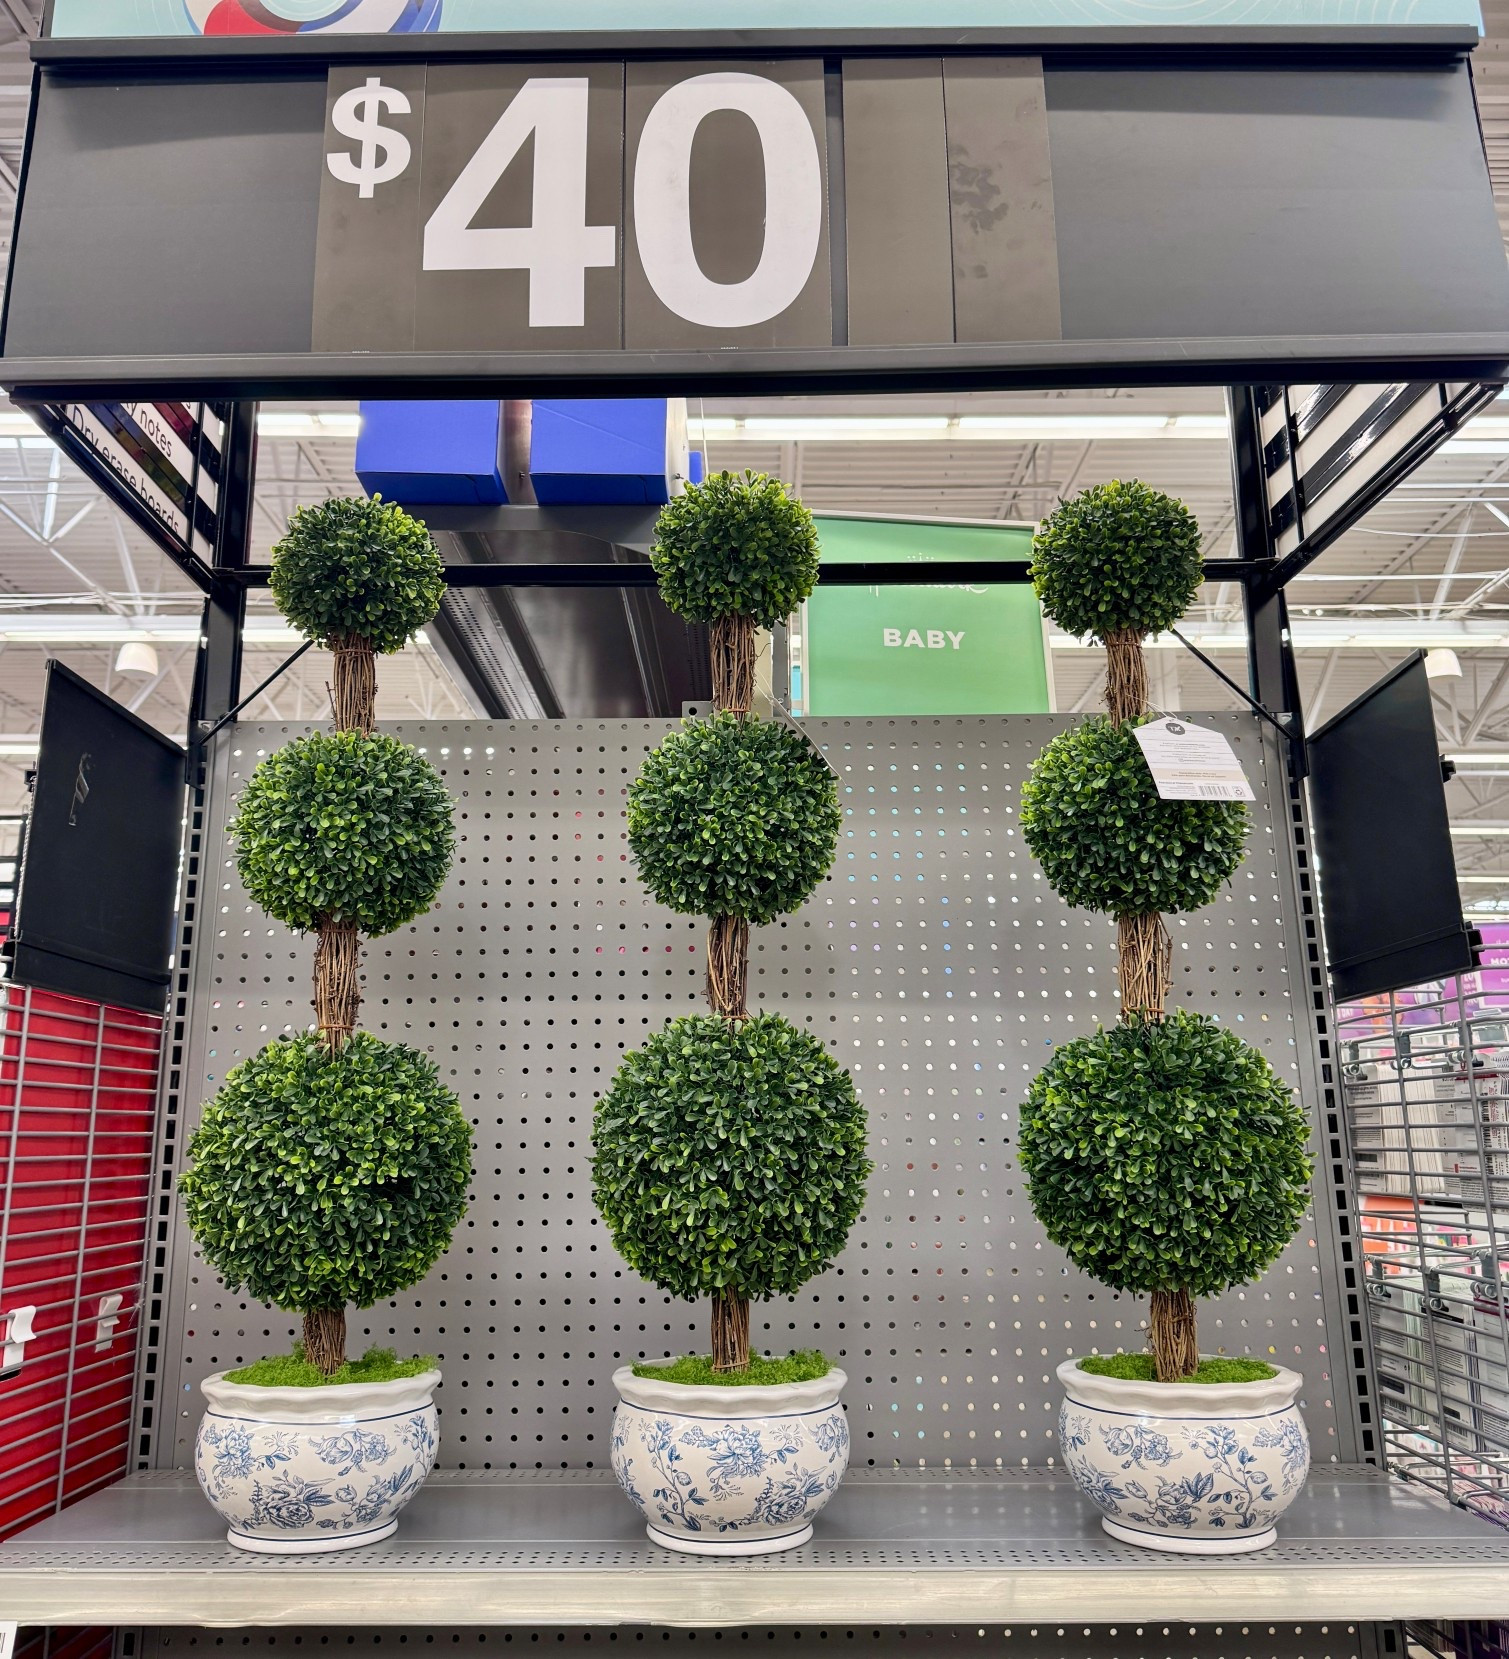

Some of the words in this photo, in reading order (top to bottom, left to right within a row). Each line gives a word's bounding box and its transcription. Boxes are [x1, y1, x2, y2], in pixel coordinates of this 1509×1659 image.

[140, 410, 173, 458] notes
[72, 404, 99, 447] Dry
[102, 447, 137, 488] erase
[140, 477, 180, 533] boards
[882, 627, 966, 650] BABY
